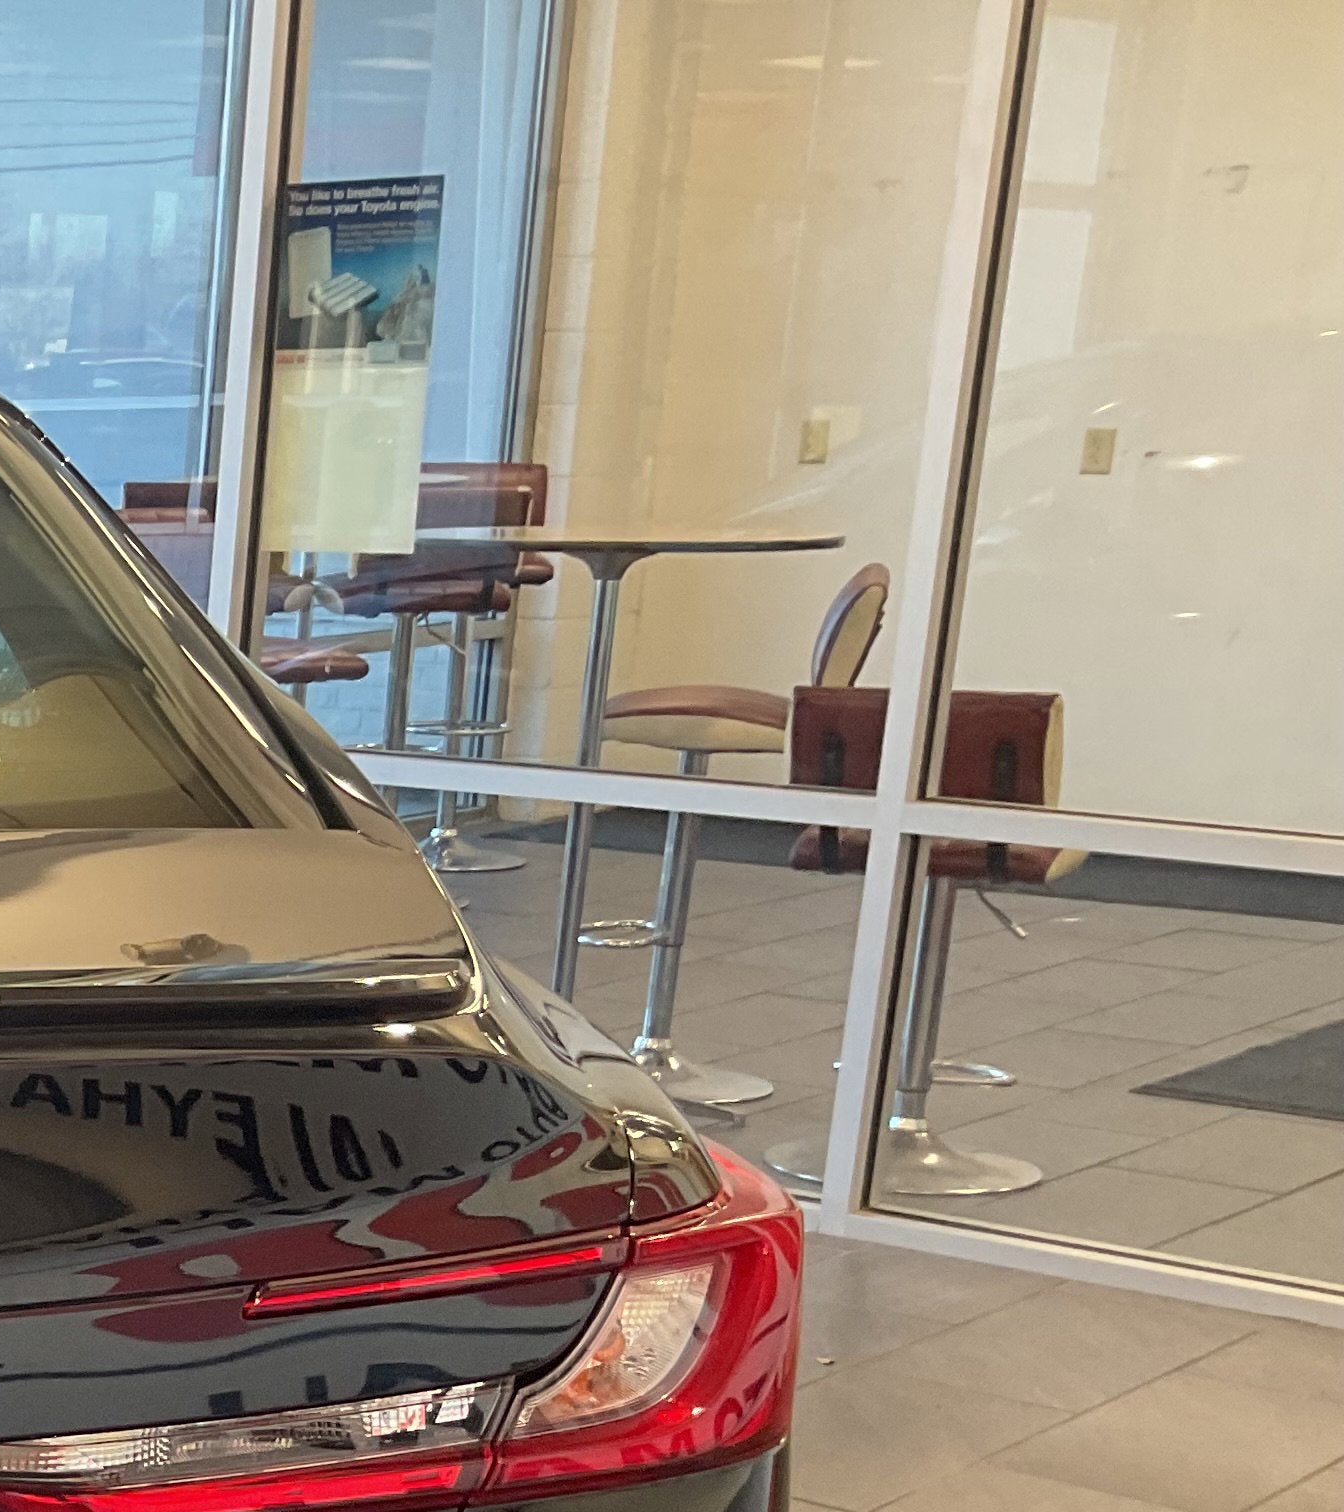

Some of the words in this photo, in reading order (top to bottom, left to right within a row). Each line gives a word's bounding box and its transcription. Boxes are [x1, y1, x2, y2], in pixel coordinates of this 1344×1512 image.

[288, 190, 309, 202] You
[333, 188, 345, 200] to
[346, 185, 390, 199] breathe
[392, 183, 421, 197] fresh
[305, 204, 332, 216] does
[334, 203, 359, 217] your
[361, 199, 398, 215] Toyota
